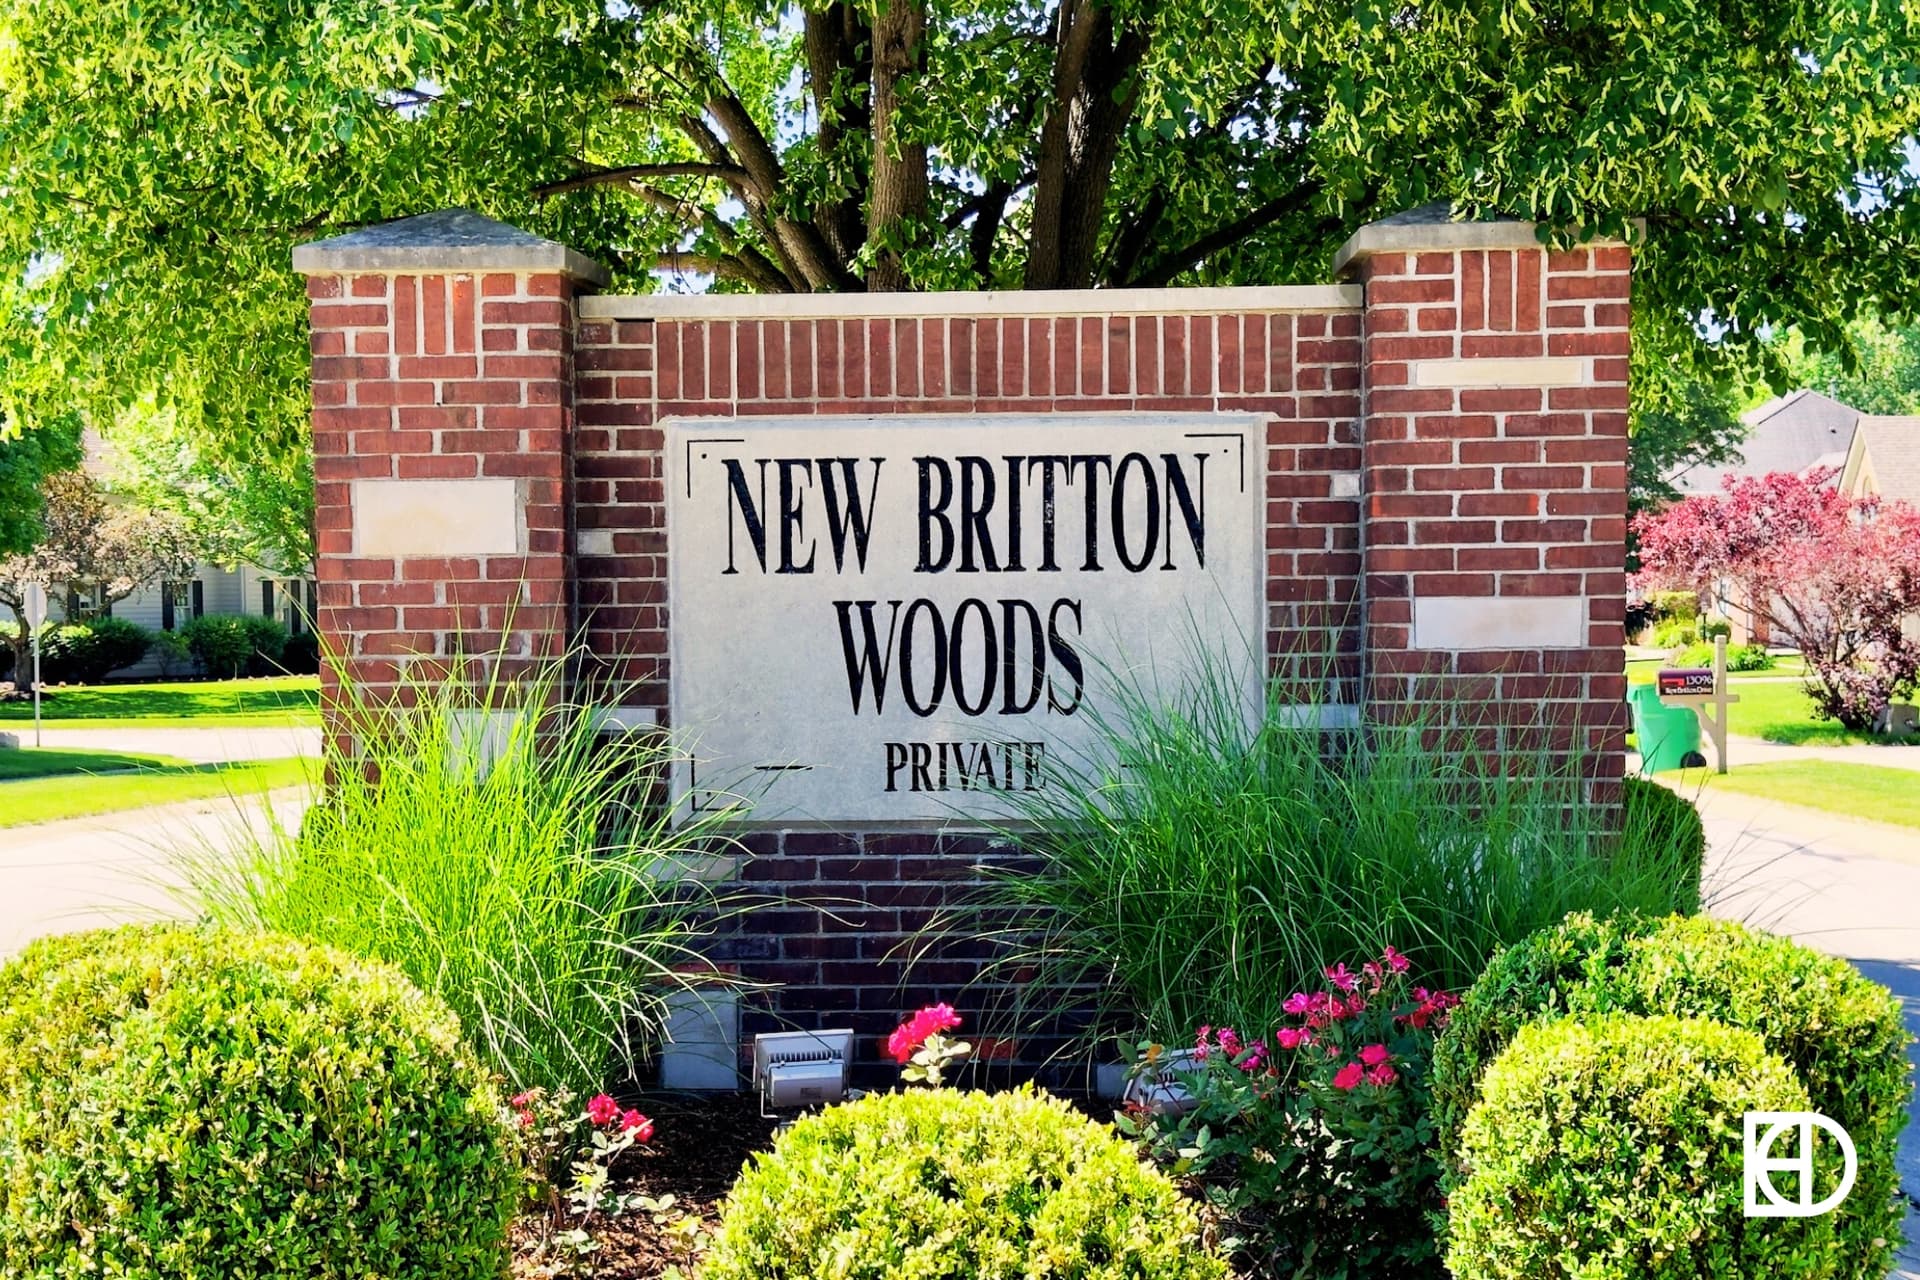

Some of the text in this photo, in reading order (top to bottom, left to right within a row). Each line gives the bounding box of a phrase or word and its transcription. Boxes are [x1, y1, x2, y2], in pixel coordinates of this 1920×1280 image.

[721, 451, 1210, 575] NEW BRITTON
[832, 597, 1084, 717] WOODS
[1686, 675, 1713, 685] 13096
[883, 742, 1047, 792] PRIVATE
